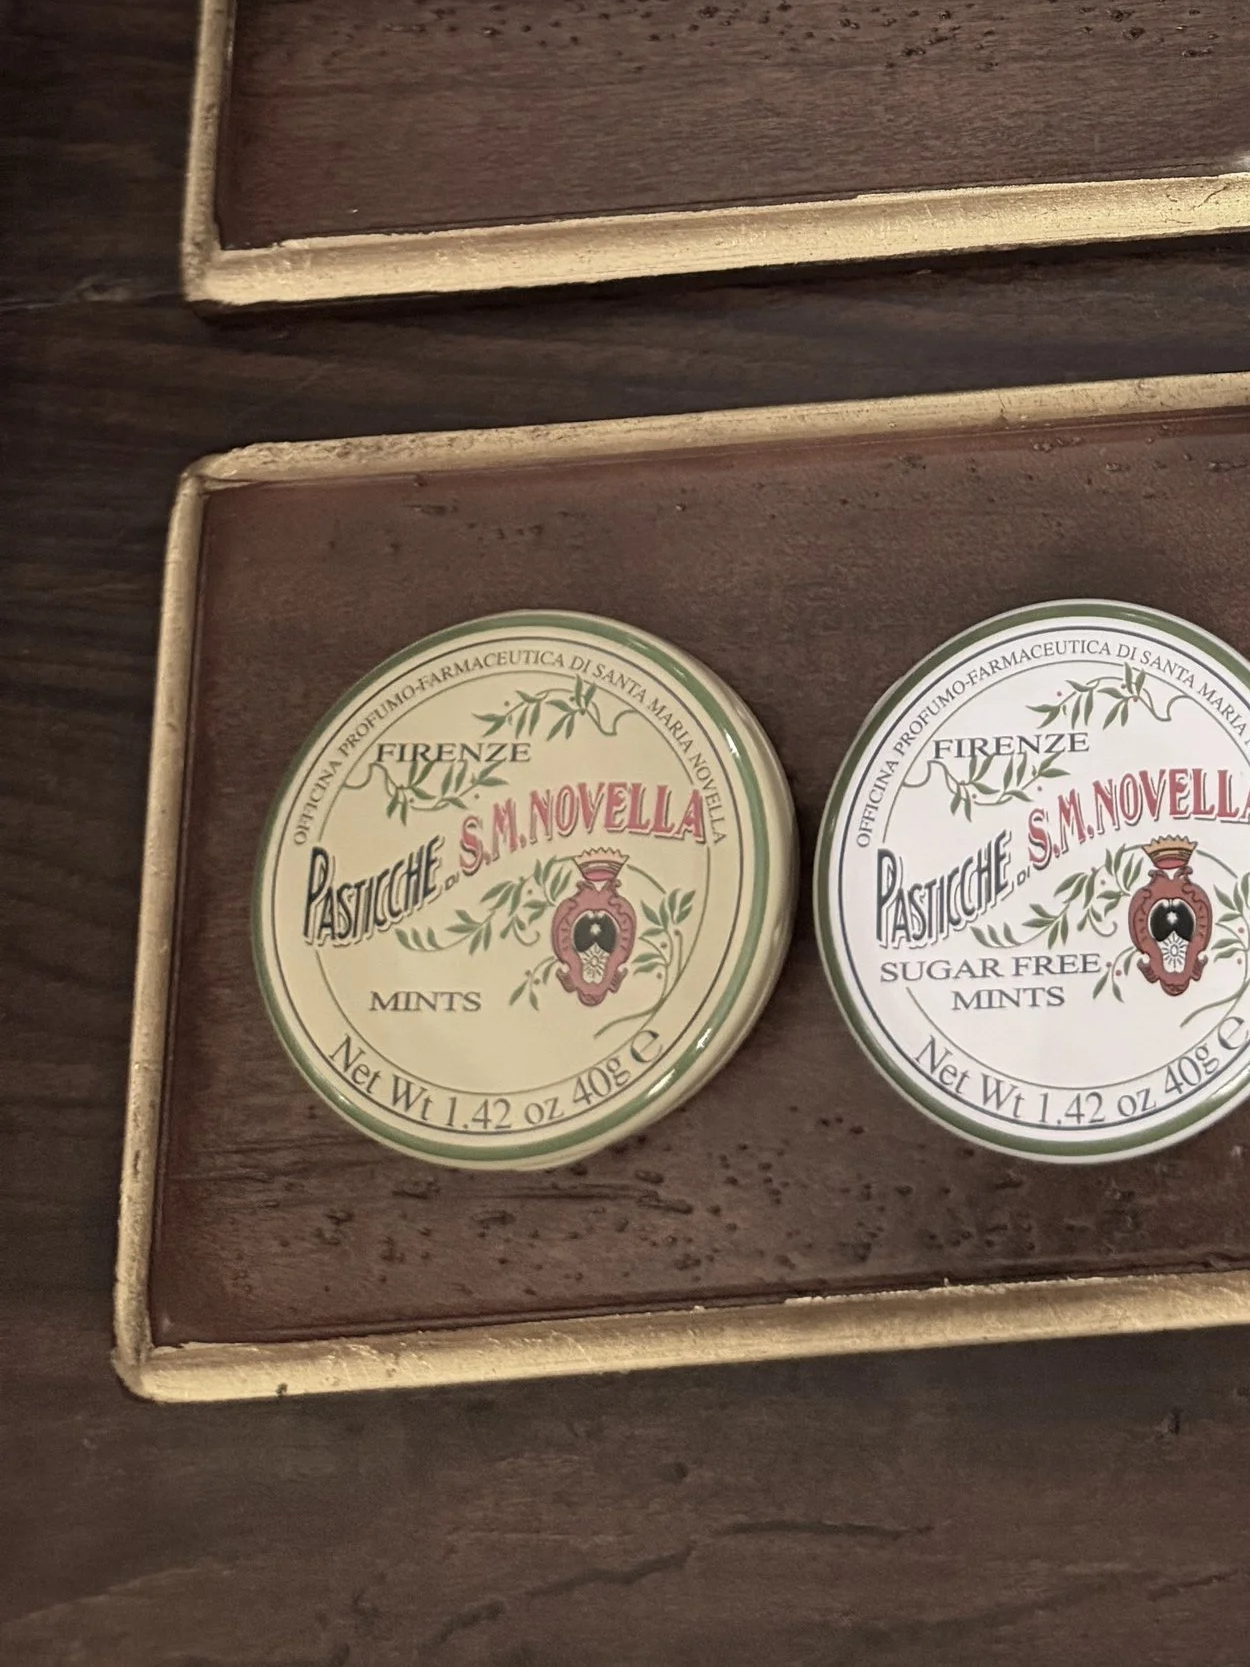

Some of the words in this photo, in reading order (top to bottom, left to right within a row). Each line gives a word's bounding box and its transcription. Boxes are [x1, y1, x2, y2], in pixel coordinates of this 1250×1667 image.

[293, 762, 345, 846] OFFICINA
[339, 648, 567, 760] PROFUMO-FARMACEUTICA
[569, 654, 593, 674] DI
[593, 662, 648, 707] SANTA
[646, 700, 695, 755] MARIA
[688, 751, 729, 846] NOVELLA
[375, 741, 532, 764] FIRENZE
[853, 754, 902, 850] OFFICINA
[892, 637, 1113, 756] PROFUMO-FARMACEUTICA
[1115, 641, 1139, 660] DI
[1140, 646, 1199, 691] SANTA
[1194, 679, 1249, 738] MARIA
[932, 731, 1090, 761] FIRENZE
[302, 833, 447, 947] PASTICCHE
[877, 828, 1013, 951] PASTICCHE
[369, 990, 482, 1013] MINTS
[879, 956, 1005, 984] SUGAR
[1011, 952, 1103, 977] FREE
[950, 986, 1066, 1012] MINTS
[328, 1033, 382, 1096] Net
[389, 1073, 435, 1122] Wt
[446, 1094, 513, 1132] 1.42
[523, 1094, 566, 1127] oz
[570, 1058, 632, 1107] 40g
[913, 1033, 971, 1096] Net
[979, 1071, 1027, 1121] Wt
[1037, 1090, 1107, 1128] 1.42
[1115, 1084, 1159, 1119] oz
[1162, 1039, 1223, 1098] 40g
